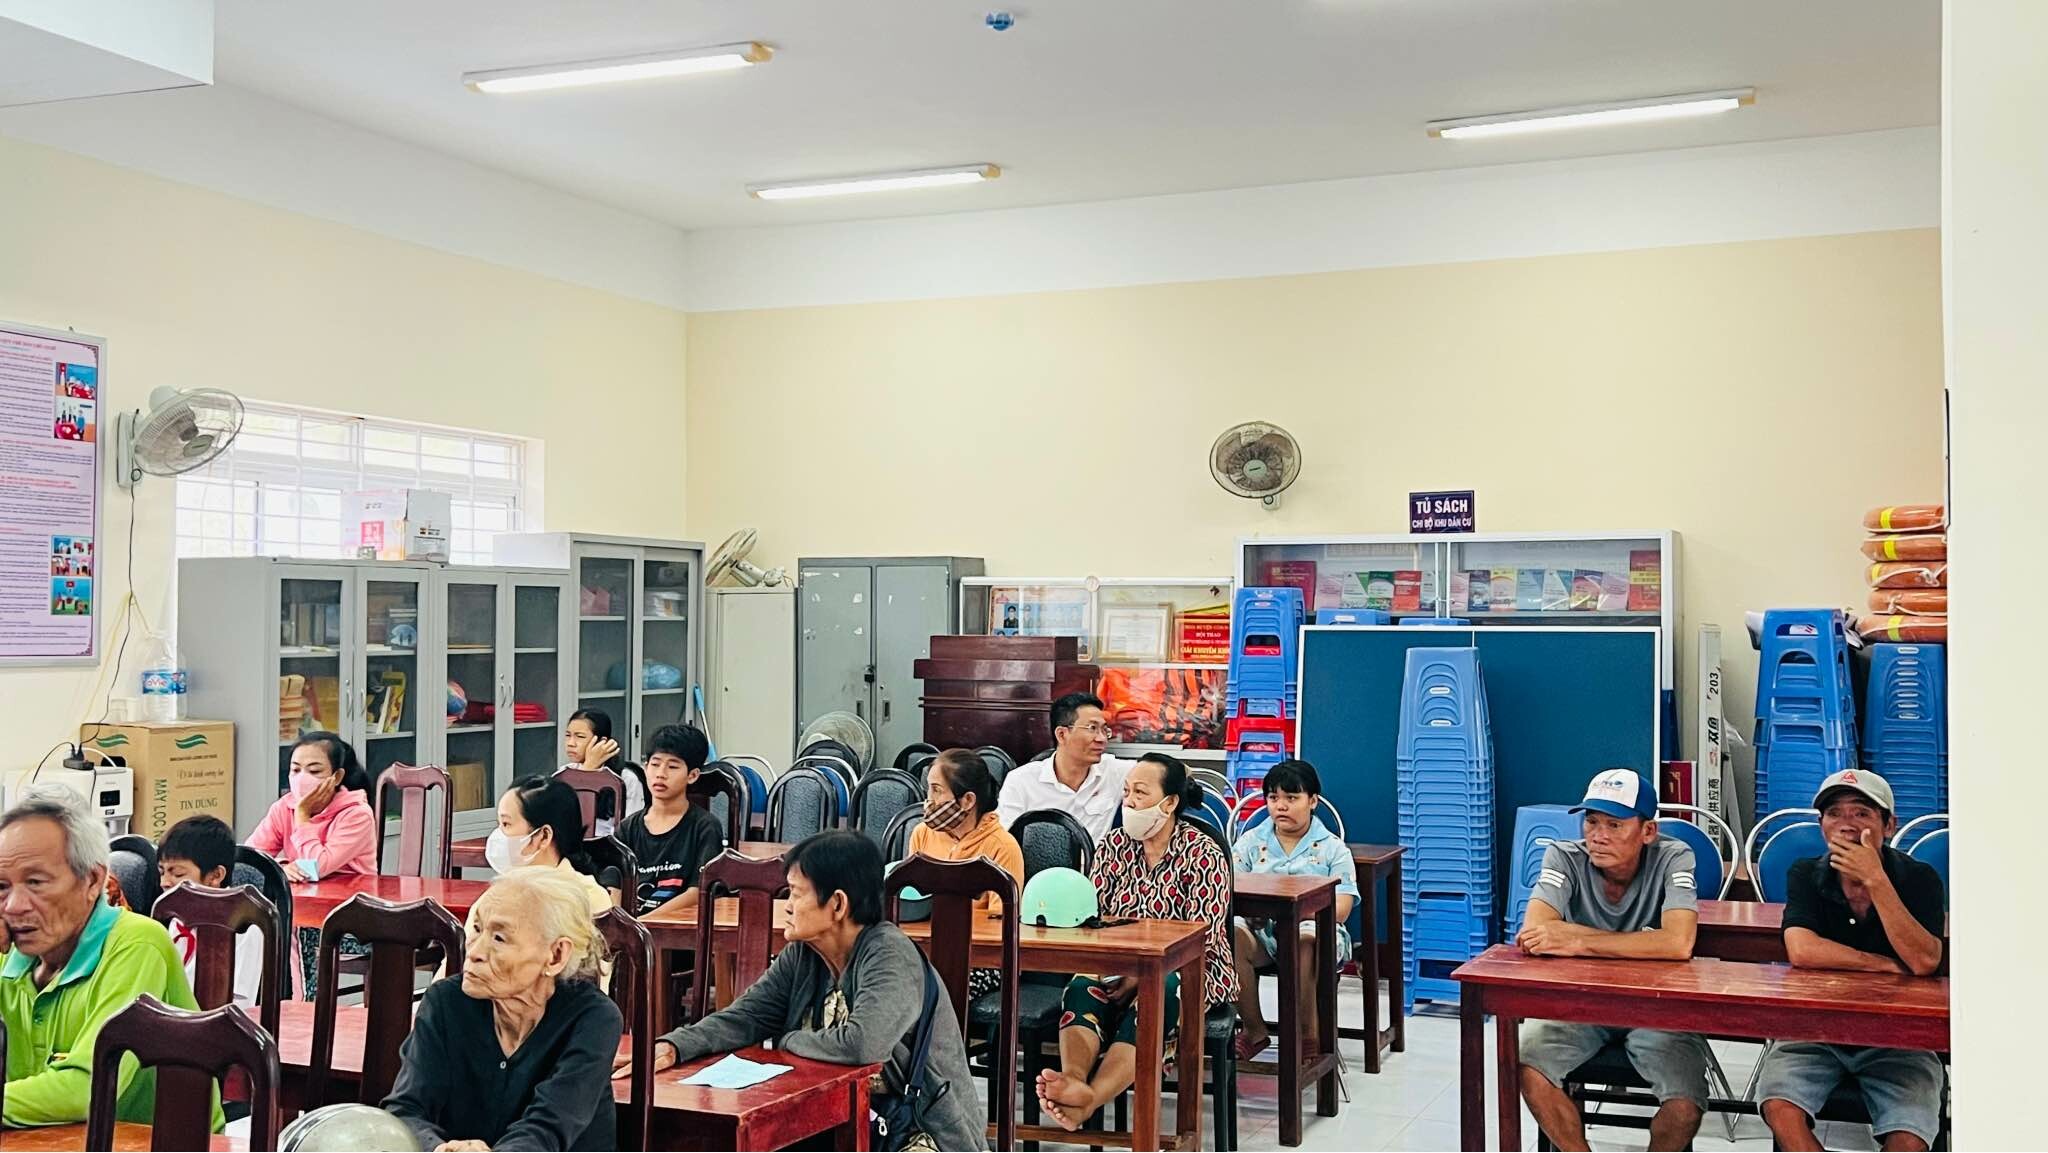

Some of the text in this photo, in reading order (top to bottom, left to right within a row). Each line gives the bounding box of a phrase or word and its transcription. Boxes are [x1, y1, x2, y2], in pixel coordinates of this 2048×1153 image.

[1416, 497, 1468, 514] TỦ SÁCH
[1412, 516, 1472, 530] CHI BỘ KHU DÂN CƯ
[638, 861, 683, 877] ampion
